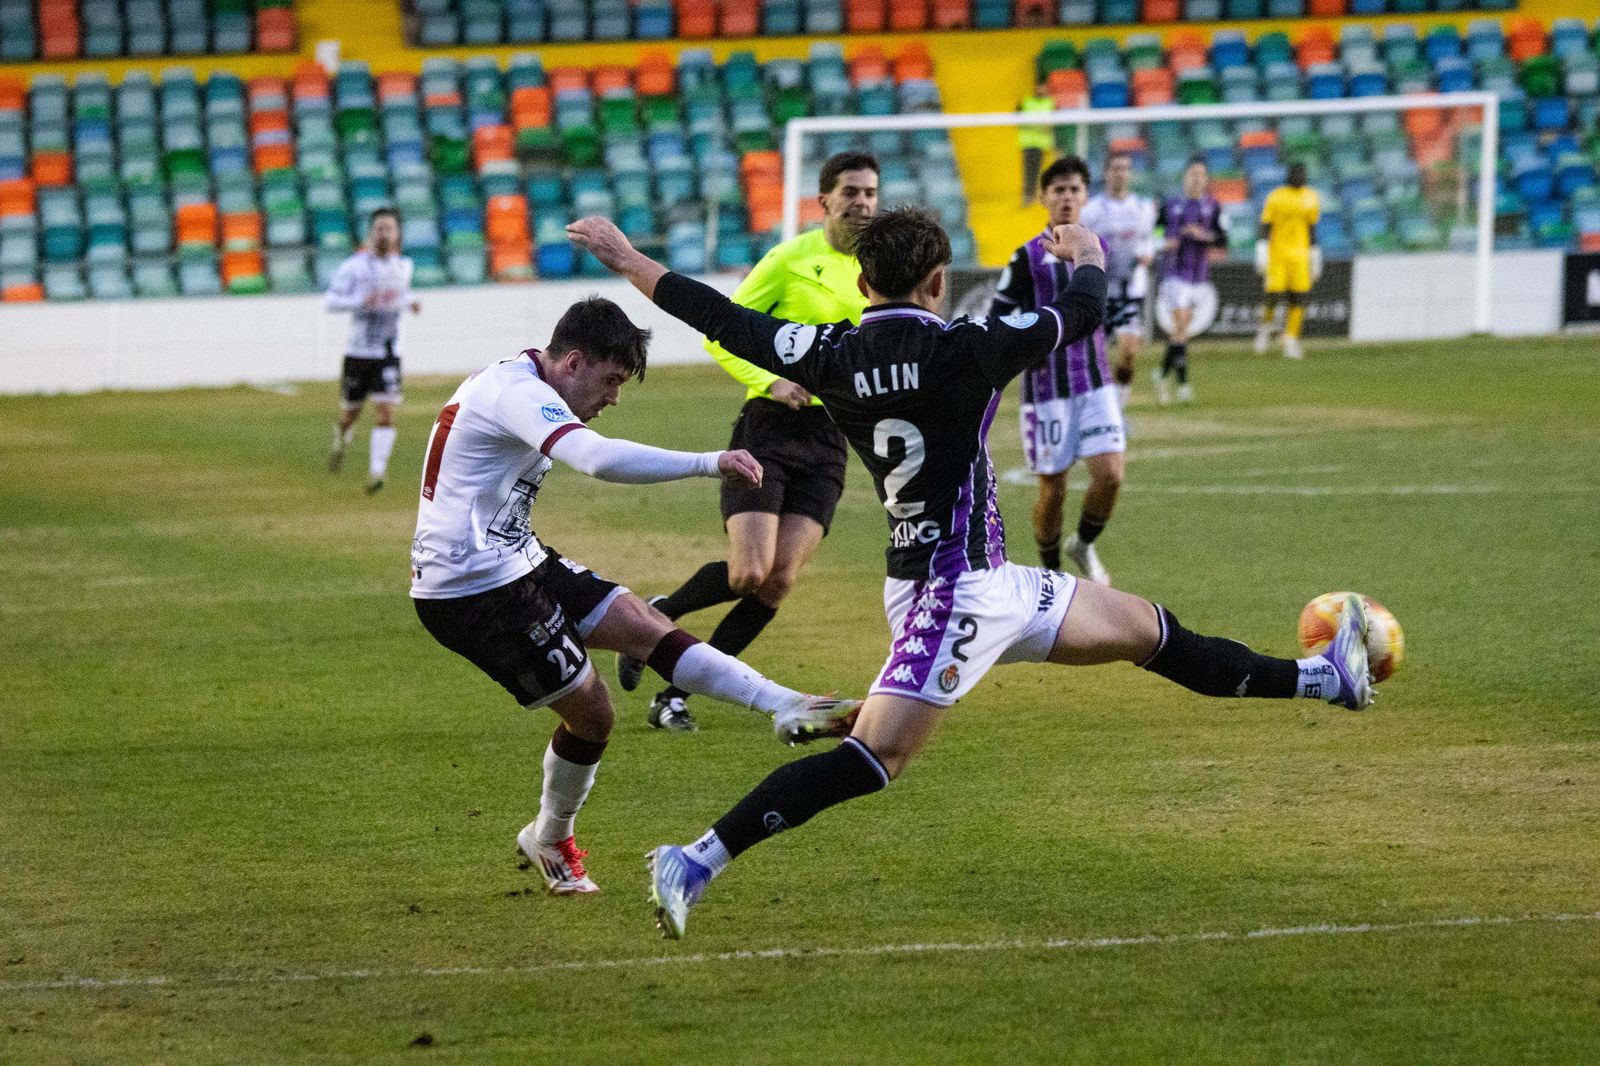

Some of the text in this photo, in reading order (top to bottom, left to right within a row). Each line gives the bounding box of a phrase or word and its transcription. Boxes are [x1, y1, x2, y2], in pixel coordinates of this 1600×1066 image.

[854, 362, 919, 399] ALIN
[1037, 419, 1061, 445] 10
[873, 418, 926, 519] 2
[1037, 567, 1055, 613] INEX
[546, 633, 585, 682] 21
[950, 615, 978, 663] 2
